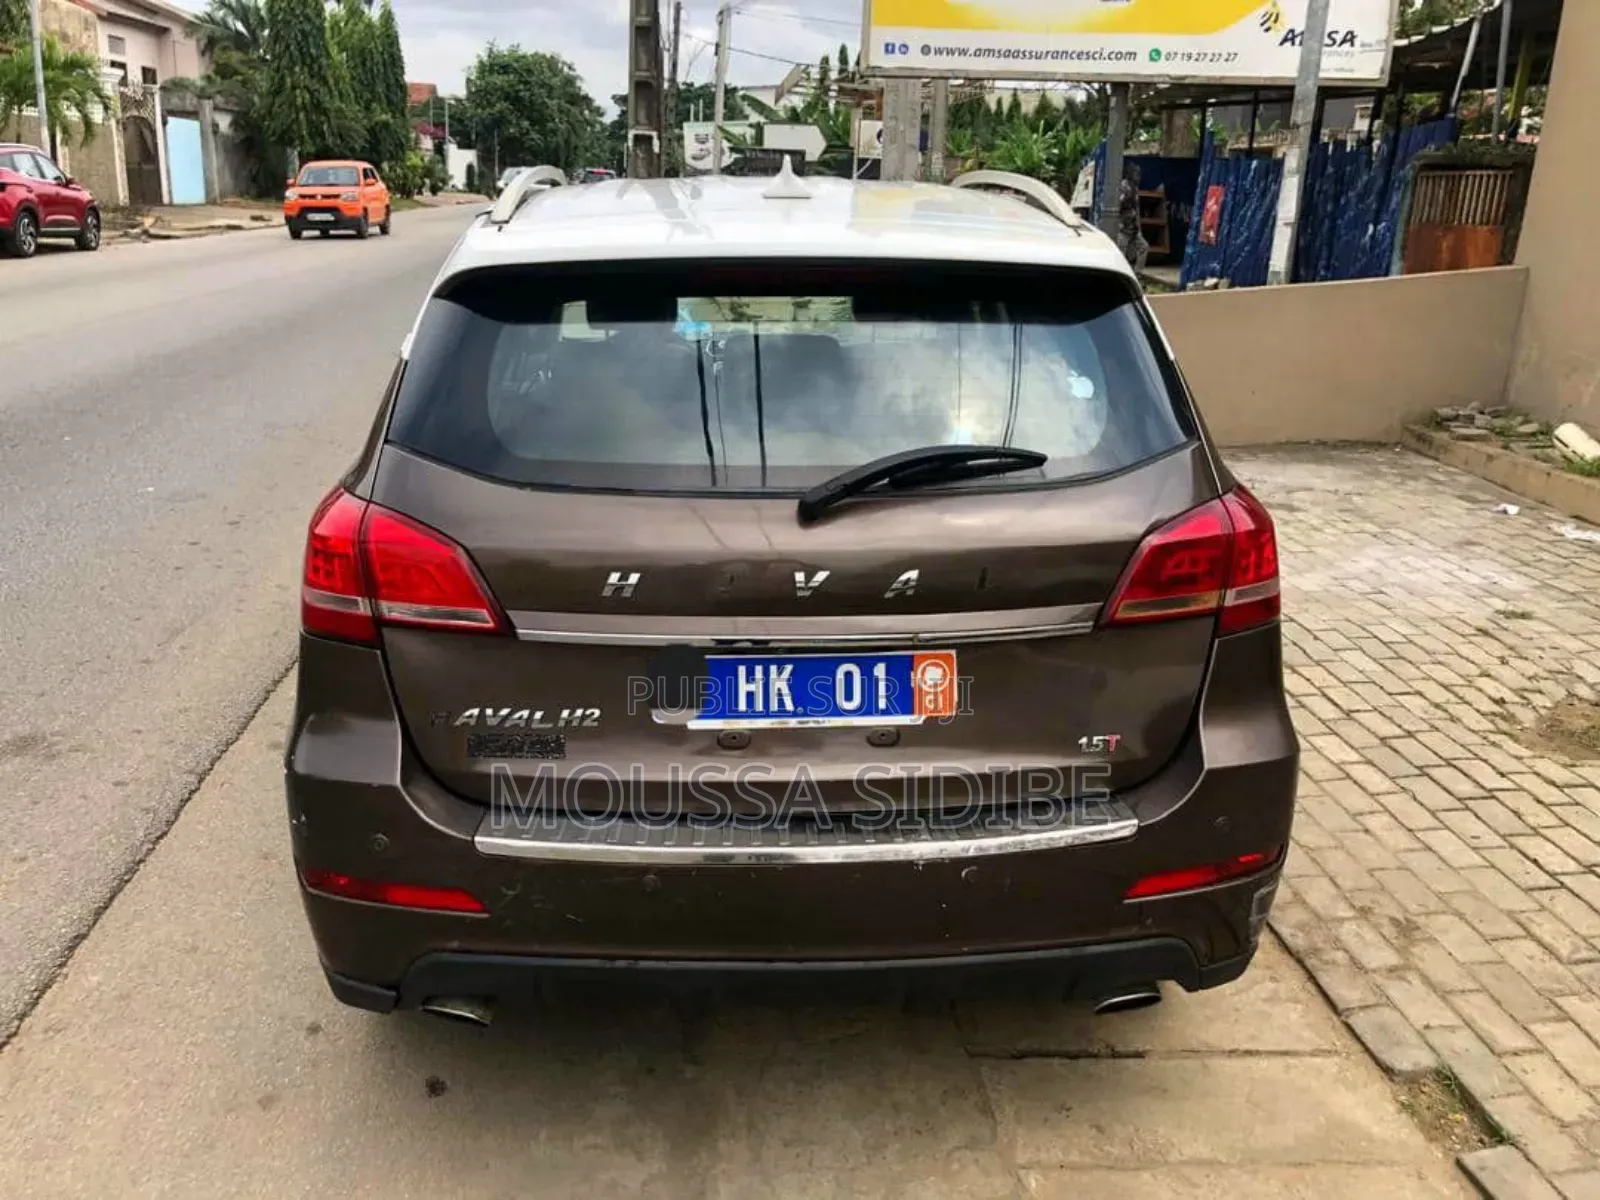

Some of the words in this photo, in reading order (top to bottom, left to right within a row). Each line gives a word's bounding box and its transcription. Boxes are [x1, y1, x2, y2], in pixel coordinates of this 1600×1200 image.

[933, 45, 1138, 62] www.amsaassurancesci.com
[1164, 51, 1178, 61] 07
[737, 663, 795, 712] HK
[835, 662, 887, 711] 01
